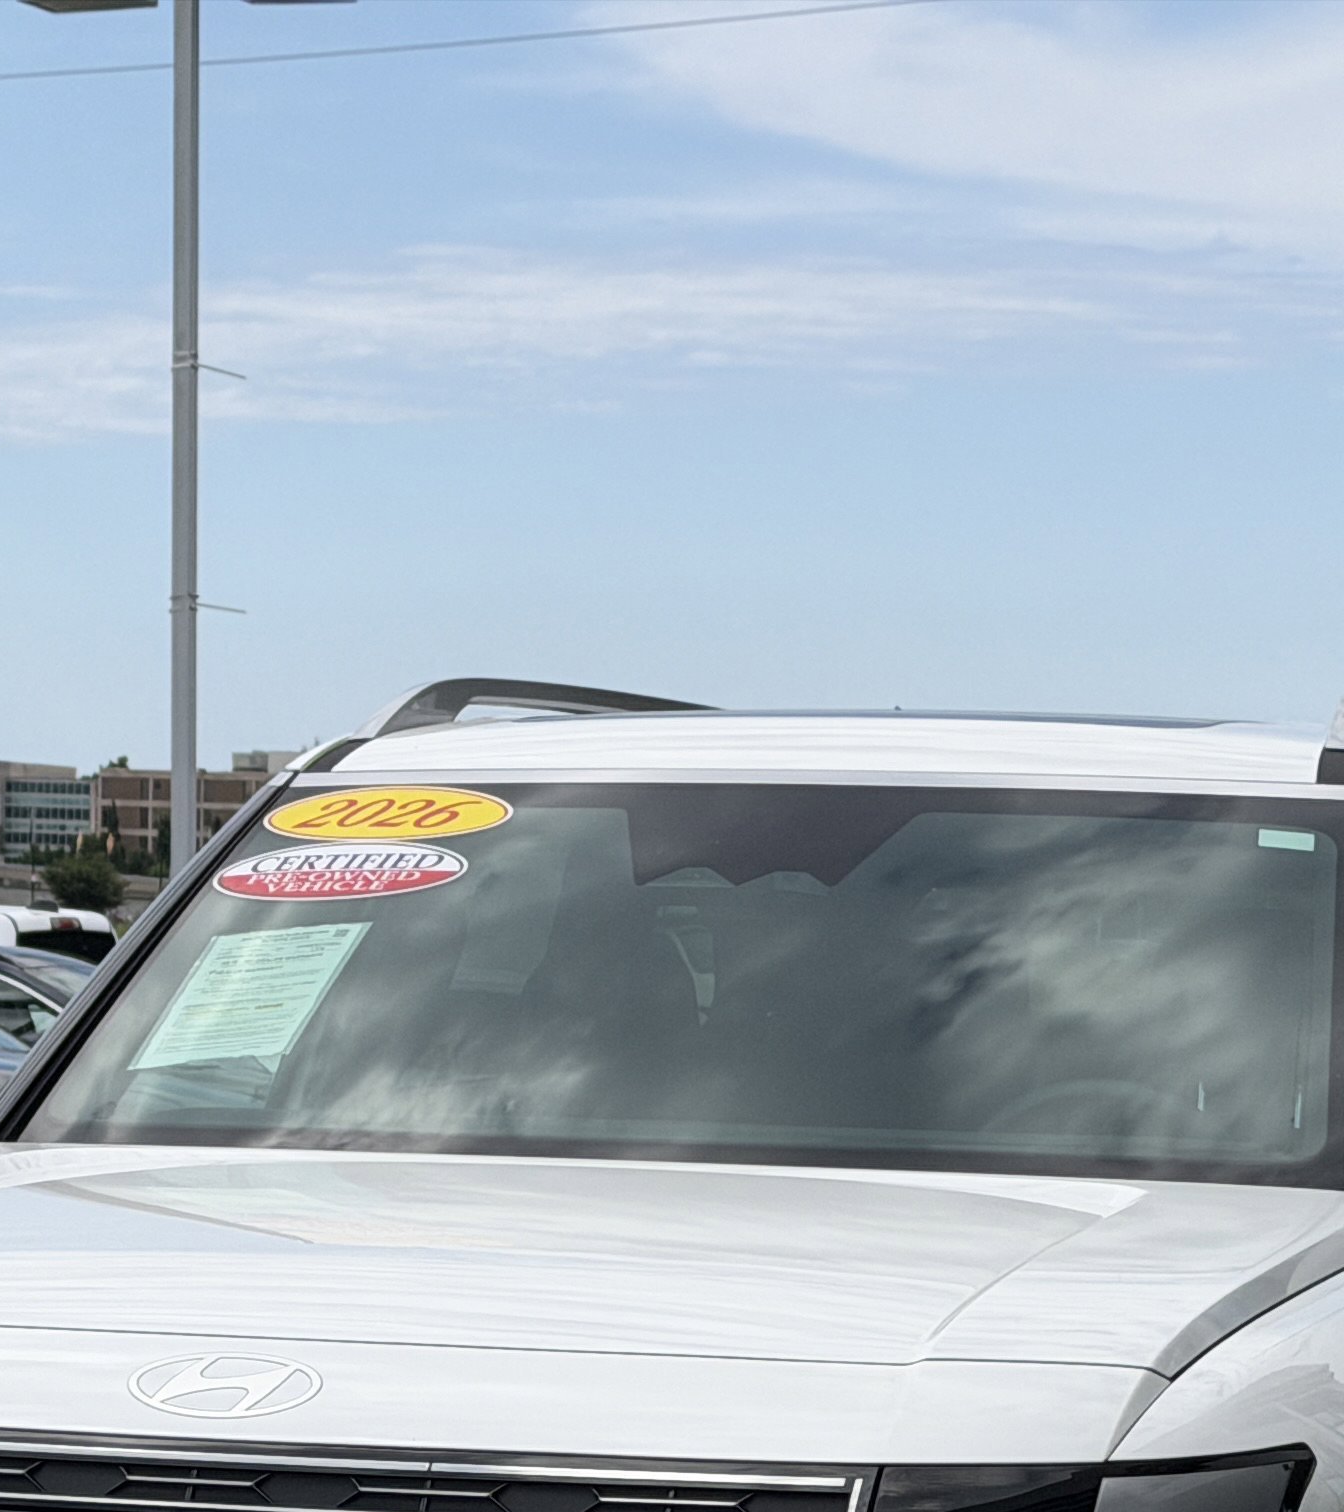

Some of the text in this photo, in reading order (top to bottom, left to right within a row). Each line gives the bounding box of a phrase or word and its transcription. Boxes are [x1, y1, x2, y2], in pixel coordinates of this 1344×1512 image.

[292, 798, 484, 829] 2026
[251, 853, 445, 873] CERTIFIED
[246, 870, 422, 886] PRE-OWNED
[266, 879, 390, 893] VEHICLE
